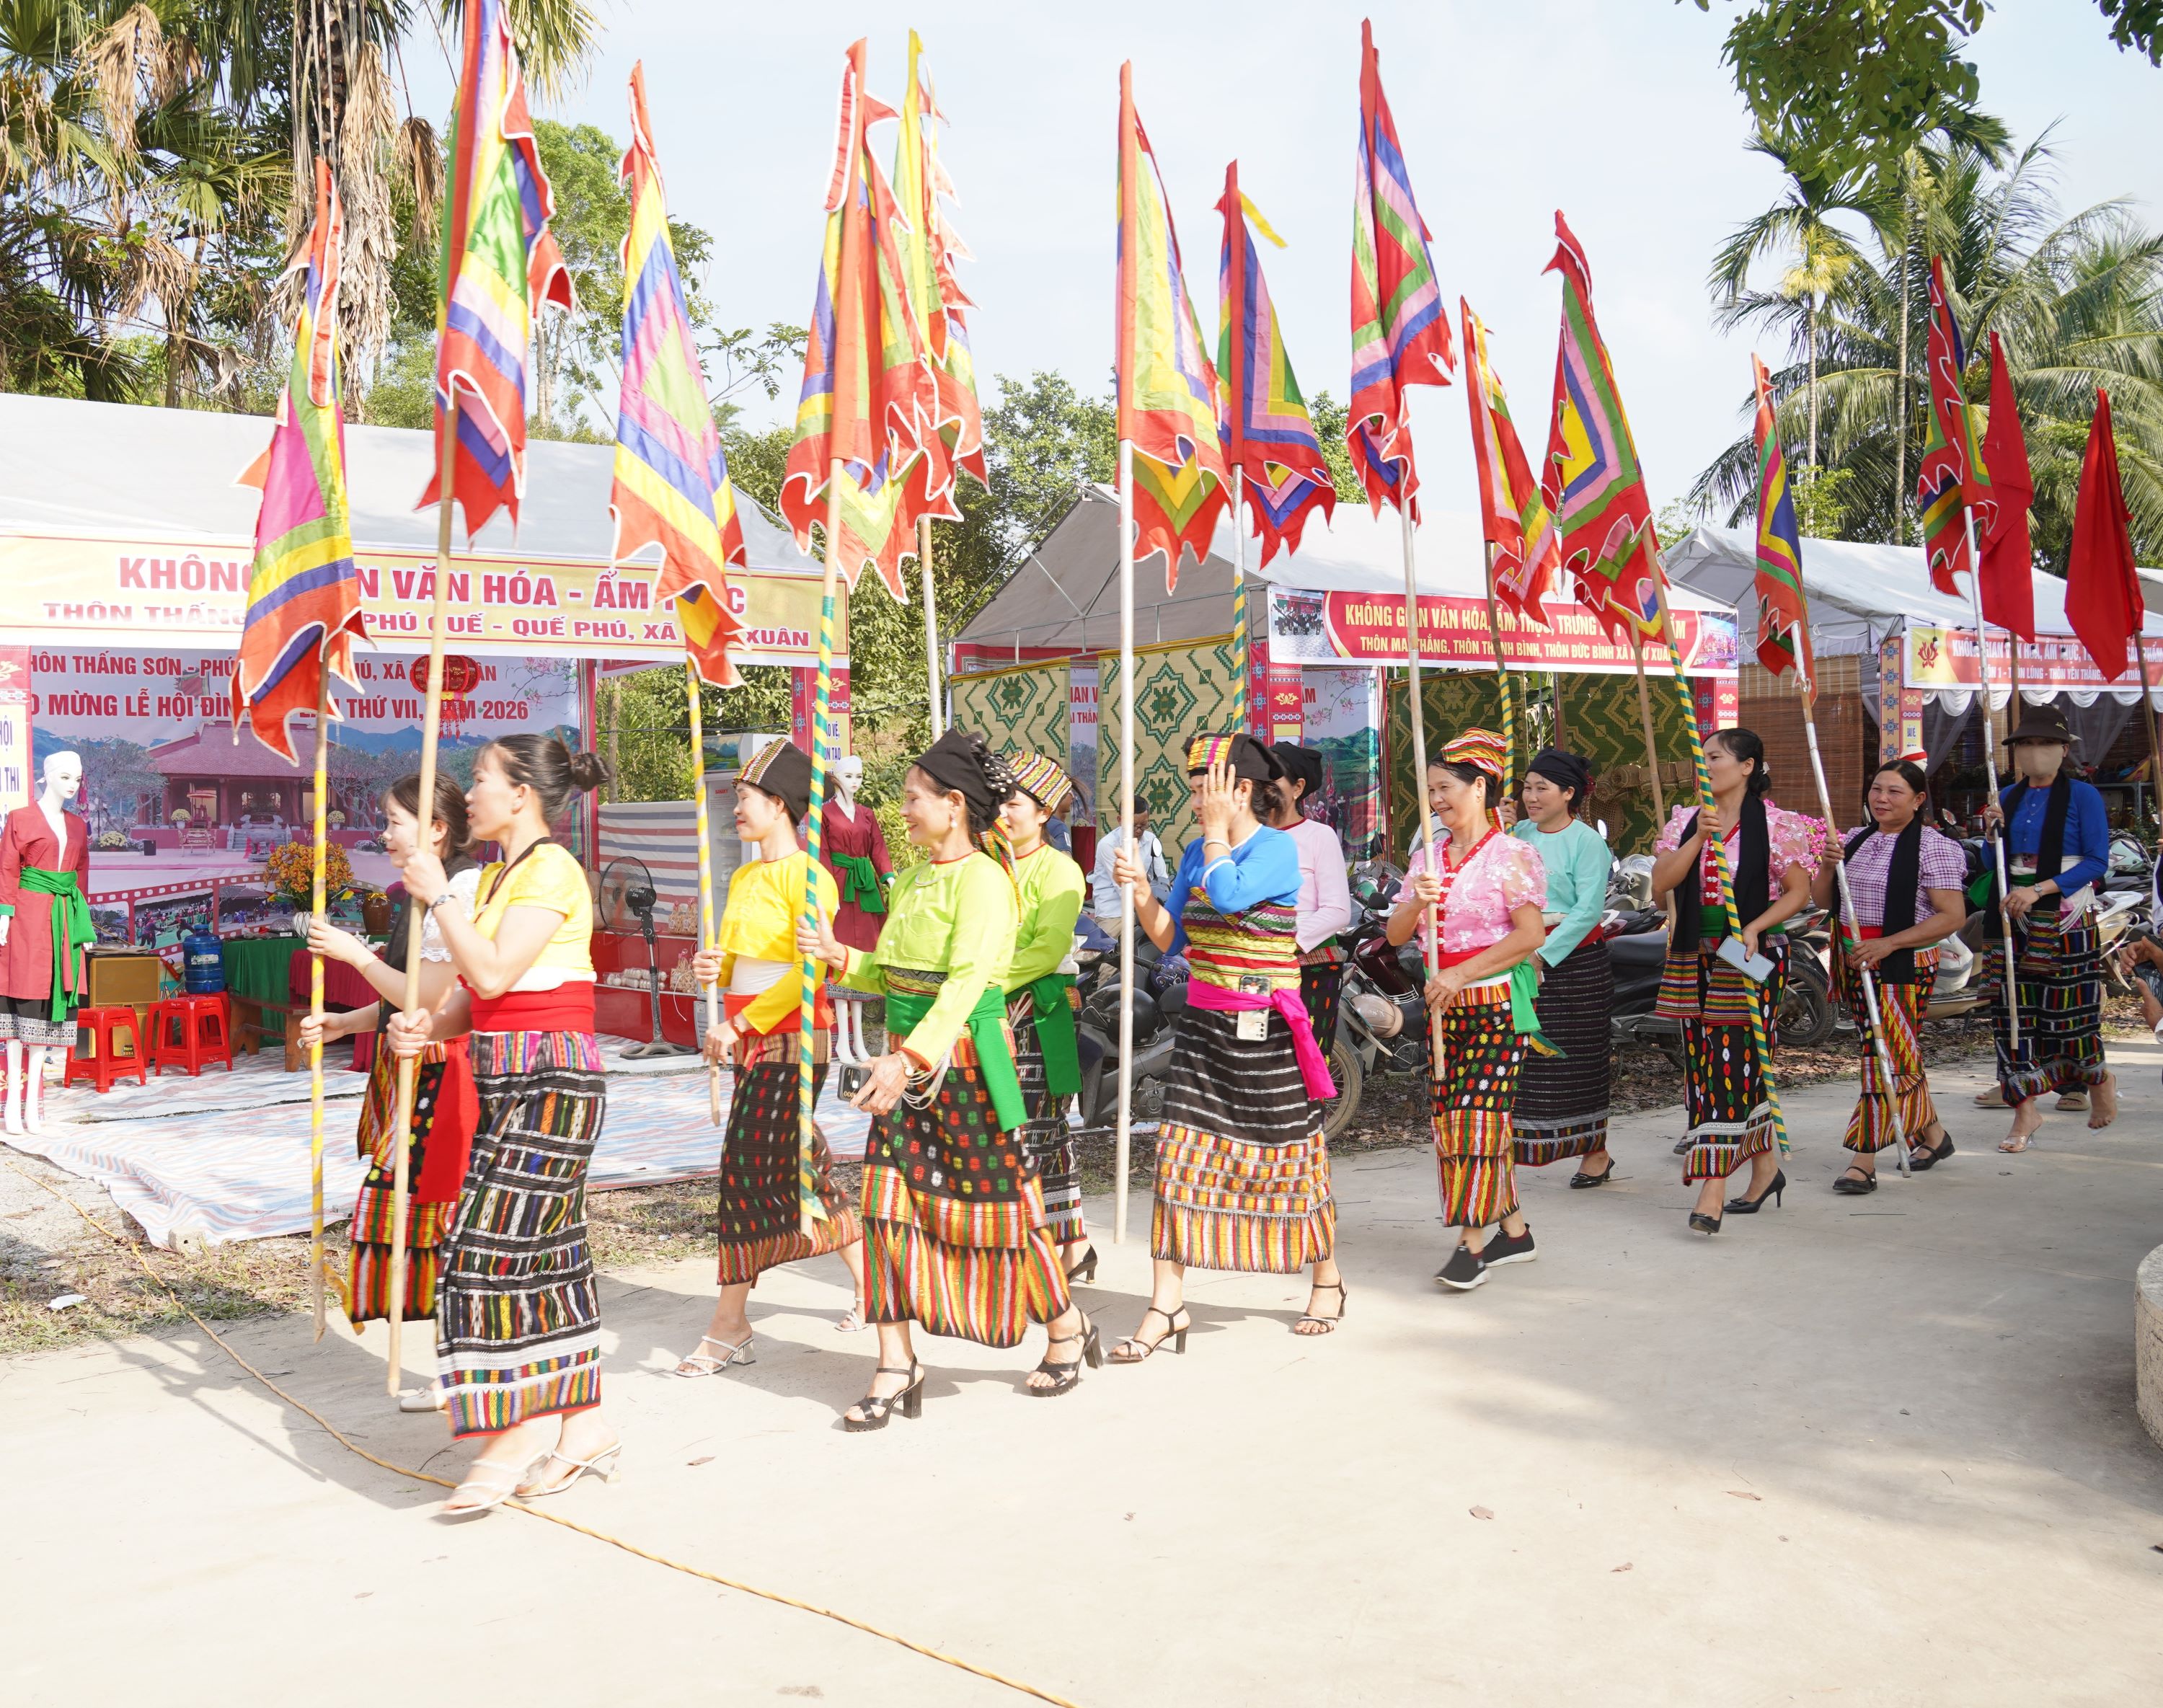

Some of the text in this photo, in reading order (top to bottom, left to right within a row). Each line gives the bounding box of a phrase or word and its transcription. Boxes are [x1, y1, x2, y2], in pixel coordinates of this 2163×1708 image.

[484, 570, 557, 606] HÓA
[594, 570, 649, 609] ẨM
[43, 601, 133, 622] THÔN
[1345, 601, 1393, 627] KHÔNG
[1397, 607, 1429, 628] GIN
[1431, 604, 1459, 629] VĂN
[1461, 606, 1492, 634] HÓA,
[1557, 614, 1597, 637] TRƯNG
[365, 611, 417, 631] PHÚ
[428, 612, 484, 633] UẾ
[513, 616, 566, 637] QUẾ
[574, 620, 634, 640] PHÚ,
[644, 621, 677, 640] XÃ
[1360, 634, 1389, 652] THÔN
[1391, 637, 1409, 652] MA
[1453, 637, 1479, 655] THÔN
[1482, 641, 1515, 656] THNH
[1516, 640, 1543, 659] BÌNH,
[1544, 641, 1570, 658] THÔN
[1572, 642, 1591, 659] ĐỨC
[1593, 643, 1614, 660] BÌNH
[1616, 645, 1629, 660] XÃ
[31, 651, 66, 673] HÔN
[143, 657, 180, 676] SƠN
[383, 660, 407, 680] XÃ
[48, 690, 118, 716] MỪNG
[125, 689, 150, 716] LỄ
[157, 693, 194, 721] HỘI
[200, 692, 233, 717] ĐÌ
[1070, 686, 1089, 703] IAN
[347, 695, 388, 718] THỨ
[392, 699, 424, 721] VII,
[482, 701, 529, 720] 2026
[1077, 707, 1098, 723] THẮN
